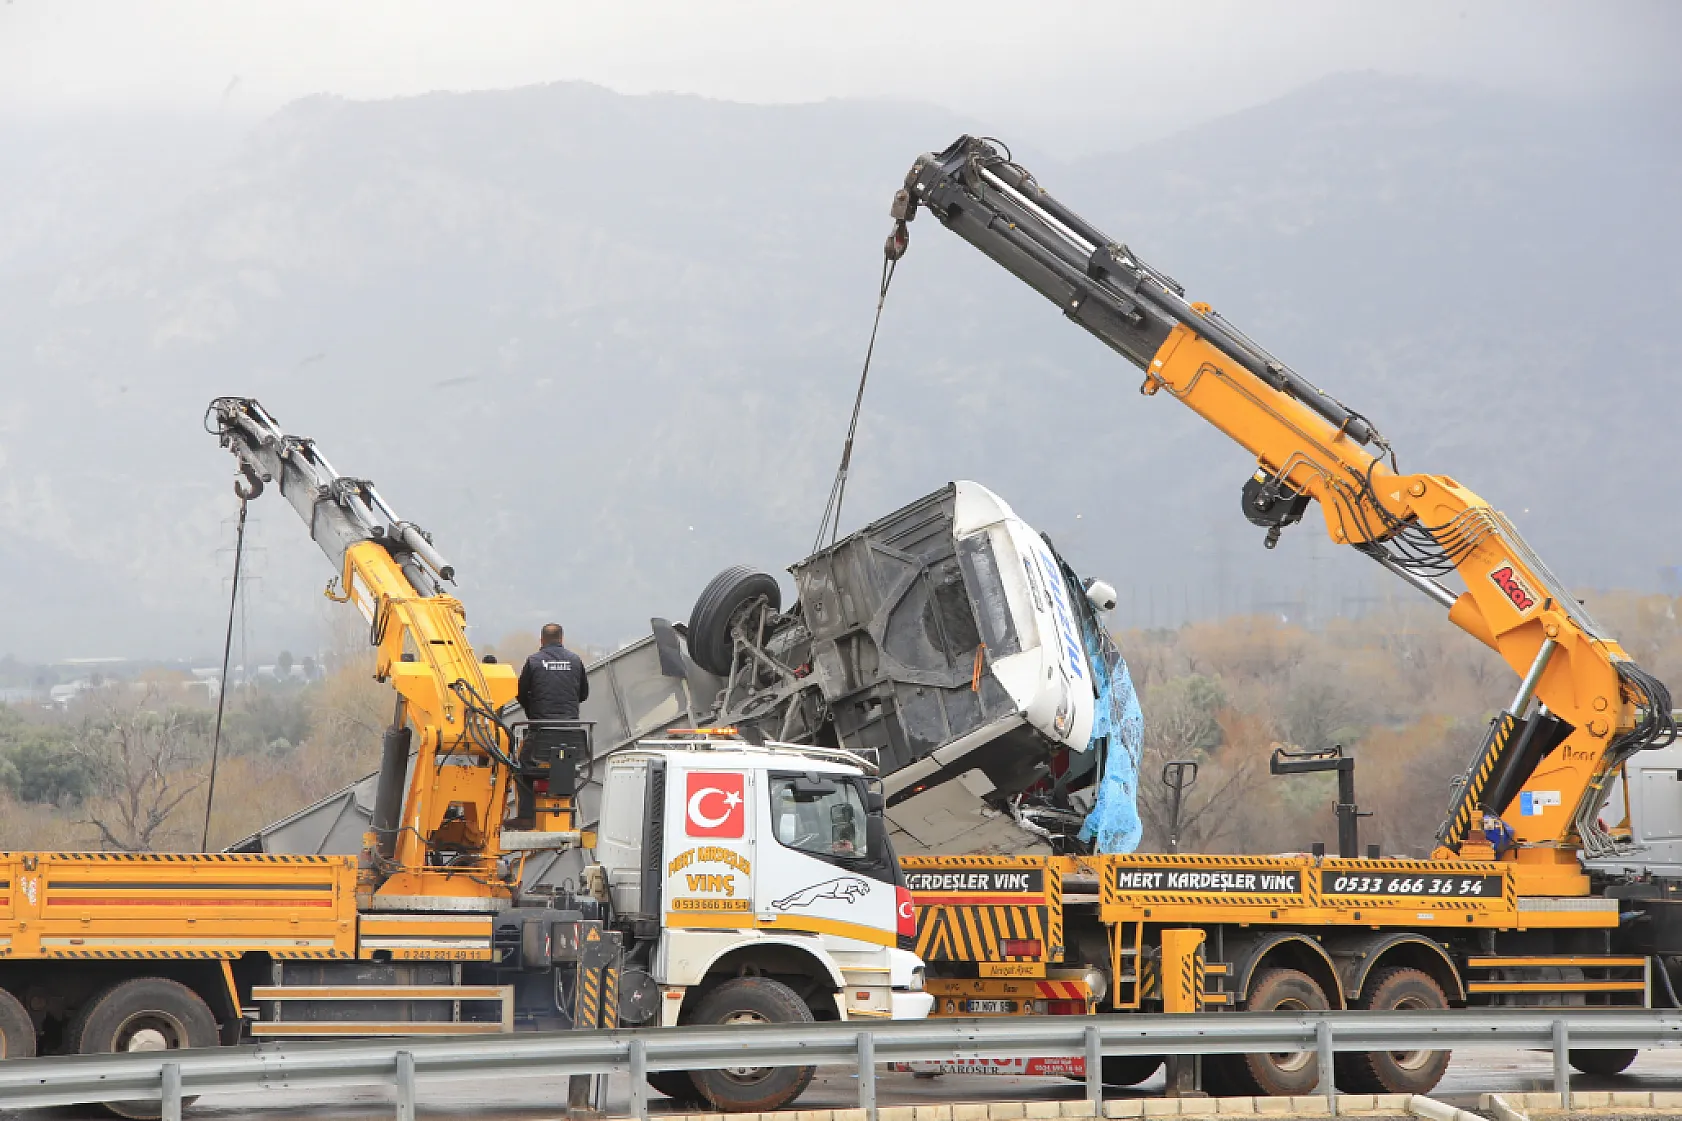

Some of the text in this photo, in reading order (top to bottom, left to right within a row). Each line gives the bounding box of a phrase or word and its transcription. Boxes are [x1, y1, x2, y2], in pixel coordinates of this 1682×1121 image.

[1491, 567, 1534, 611] Acar
[668, 848, 695, 878] MERT
[1119, 872, 1164, 890] MERT
[1167, 872, 1256, 892] KARDEŞLER
[1334, 876, 1483, 895] 0533 666 36 54
